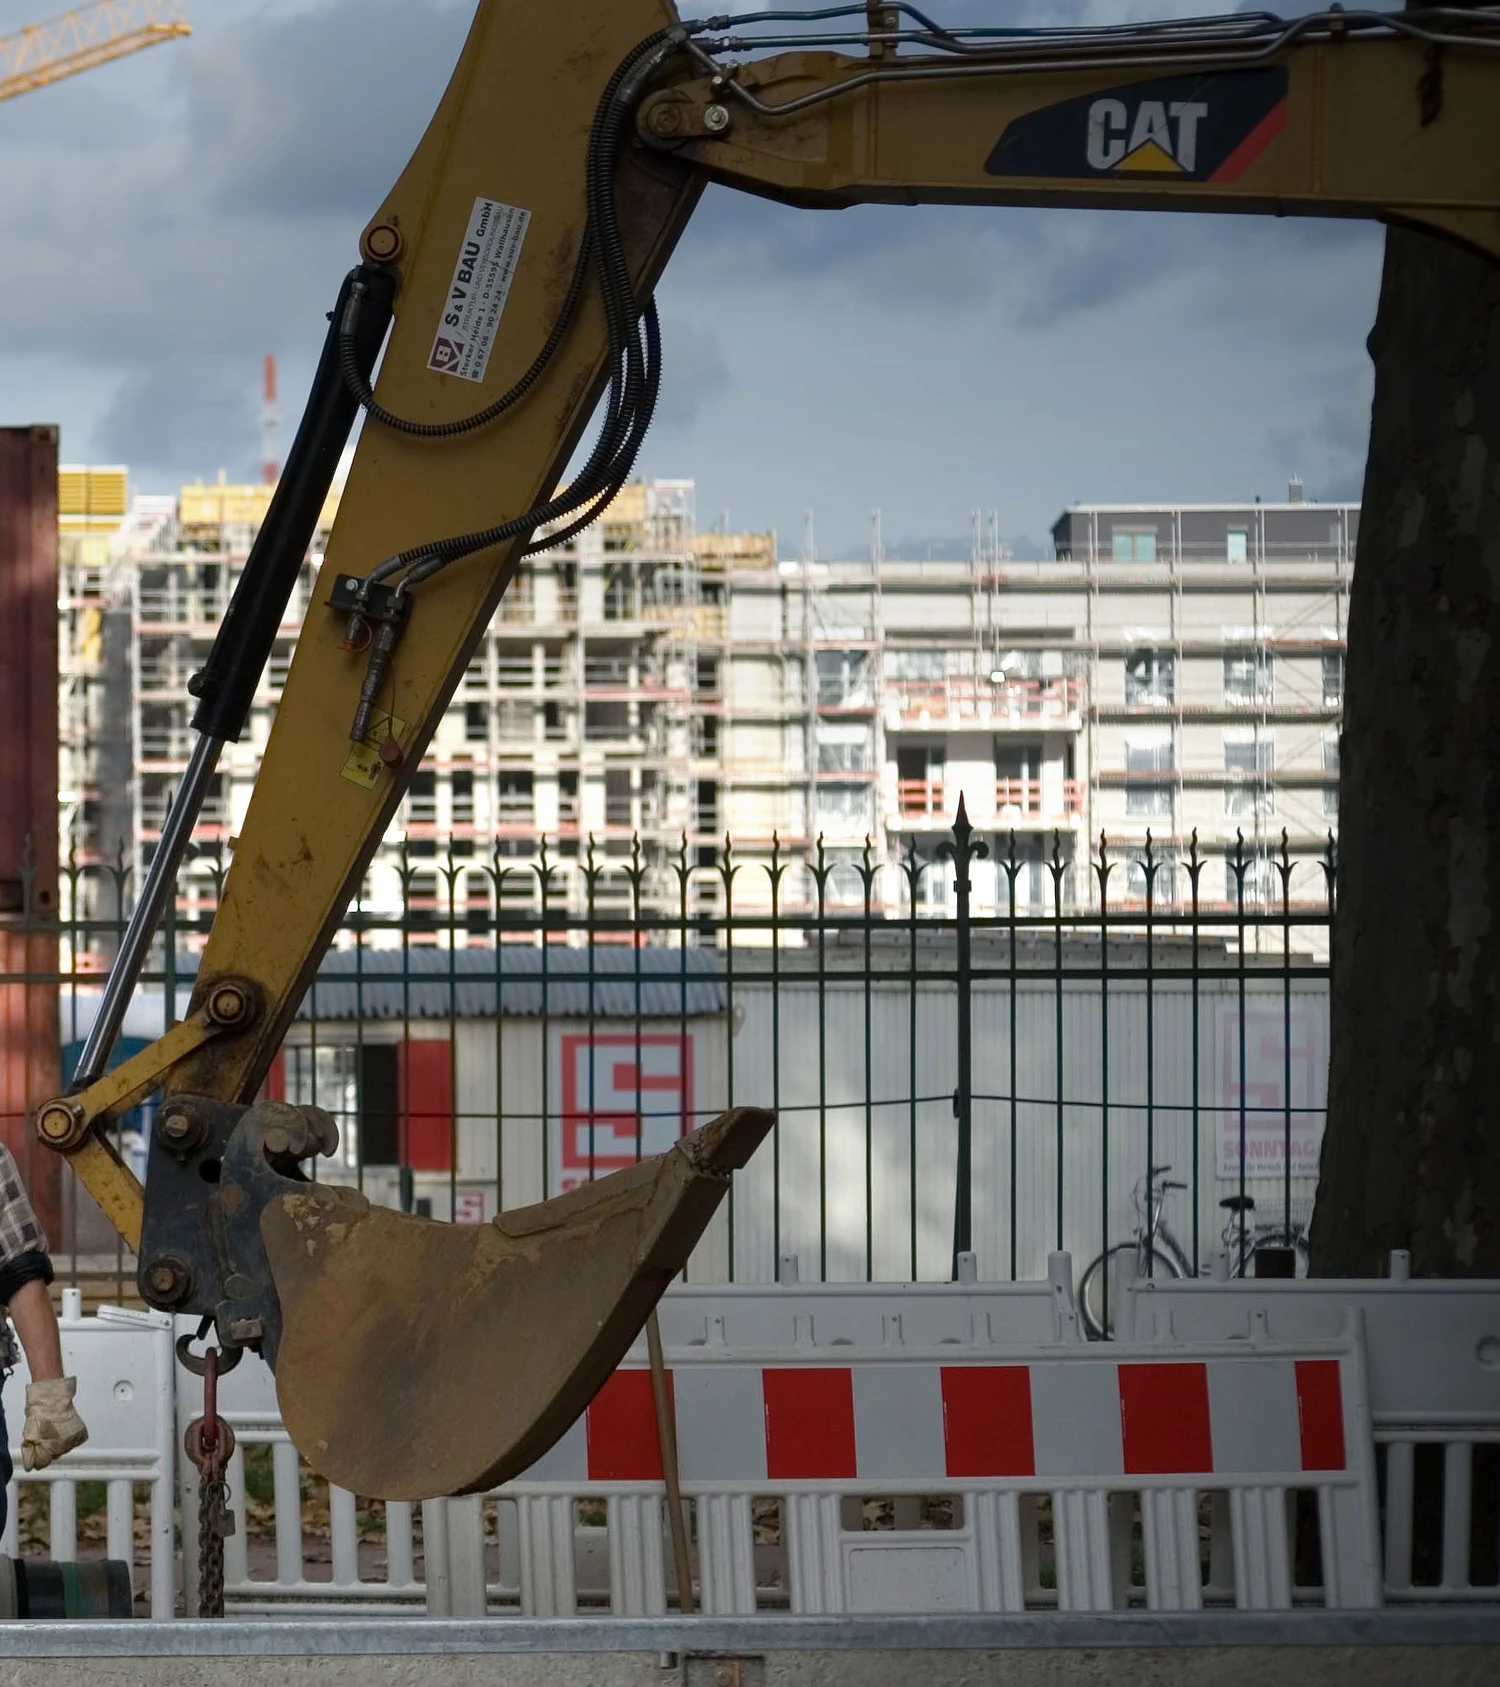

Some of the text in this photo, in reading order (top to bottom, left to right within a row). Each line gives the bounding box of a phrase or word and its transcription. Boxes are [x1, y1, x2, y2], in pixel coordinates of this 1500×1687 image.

[1087, 98, 1208, 172] CAT
[445, 202, 493, 327] S & V BAU GmbH
[471, 315, 483, 341] Heide
[495, 208, 515, 258] Wallhausen
[502, 211, 525, 282] www.suv-bau.de
